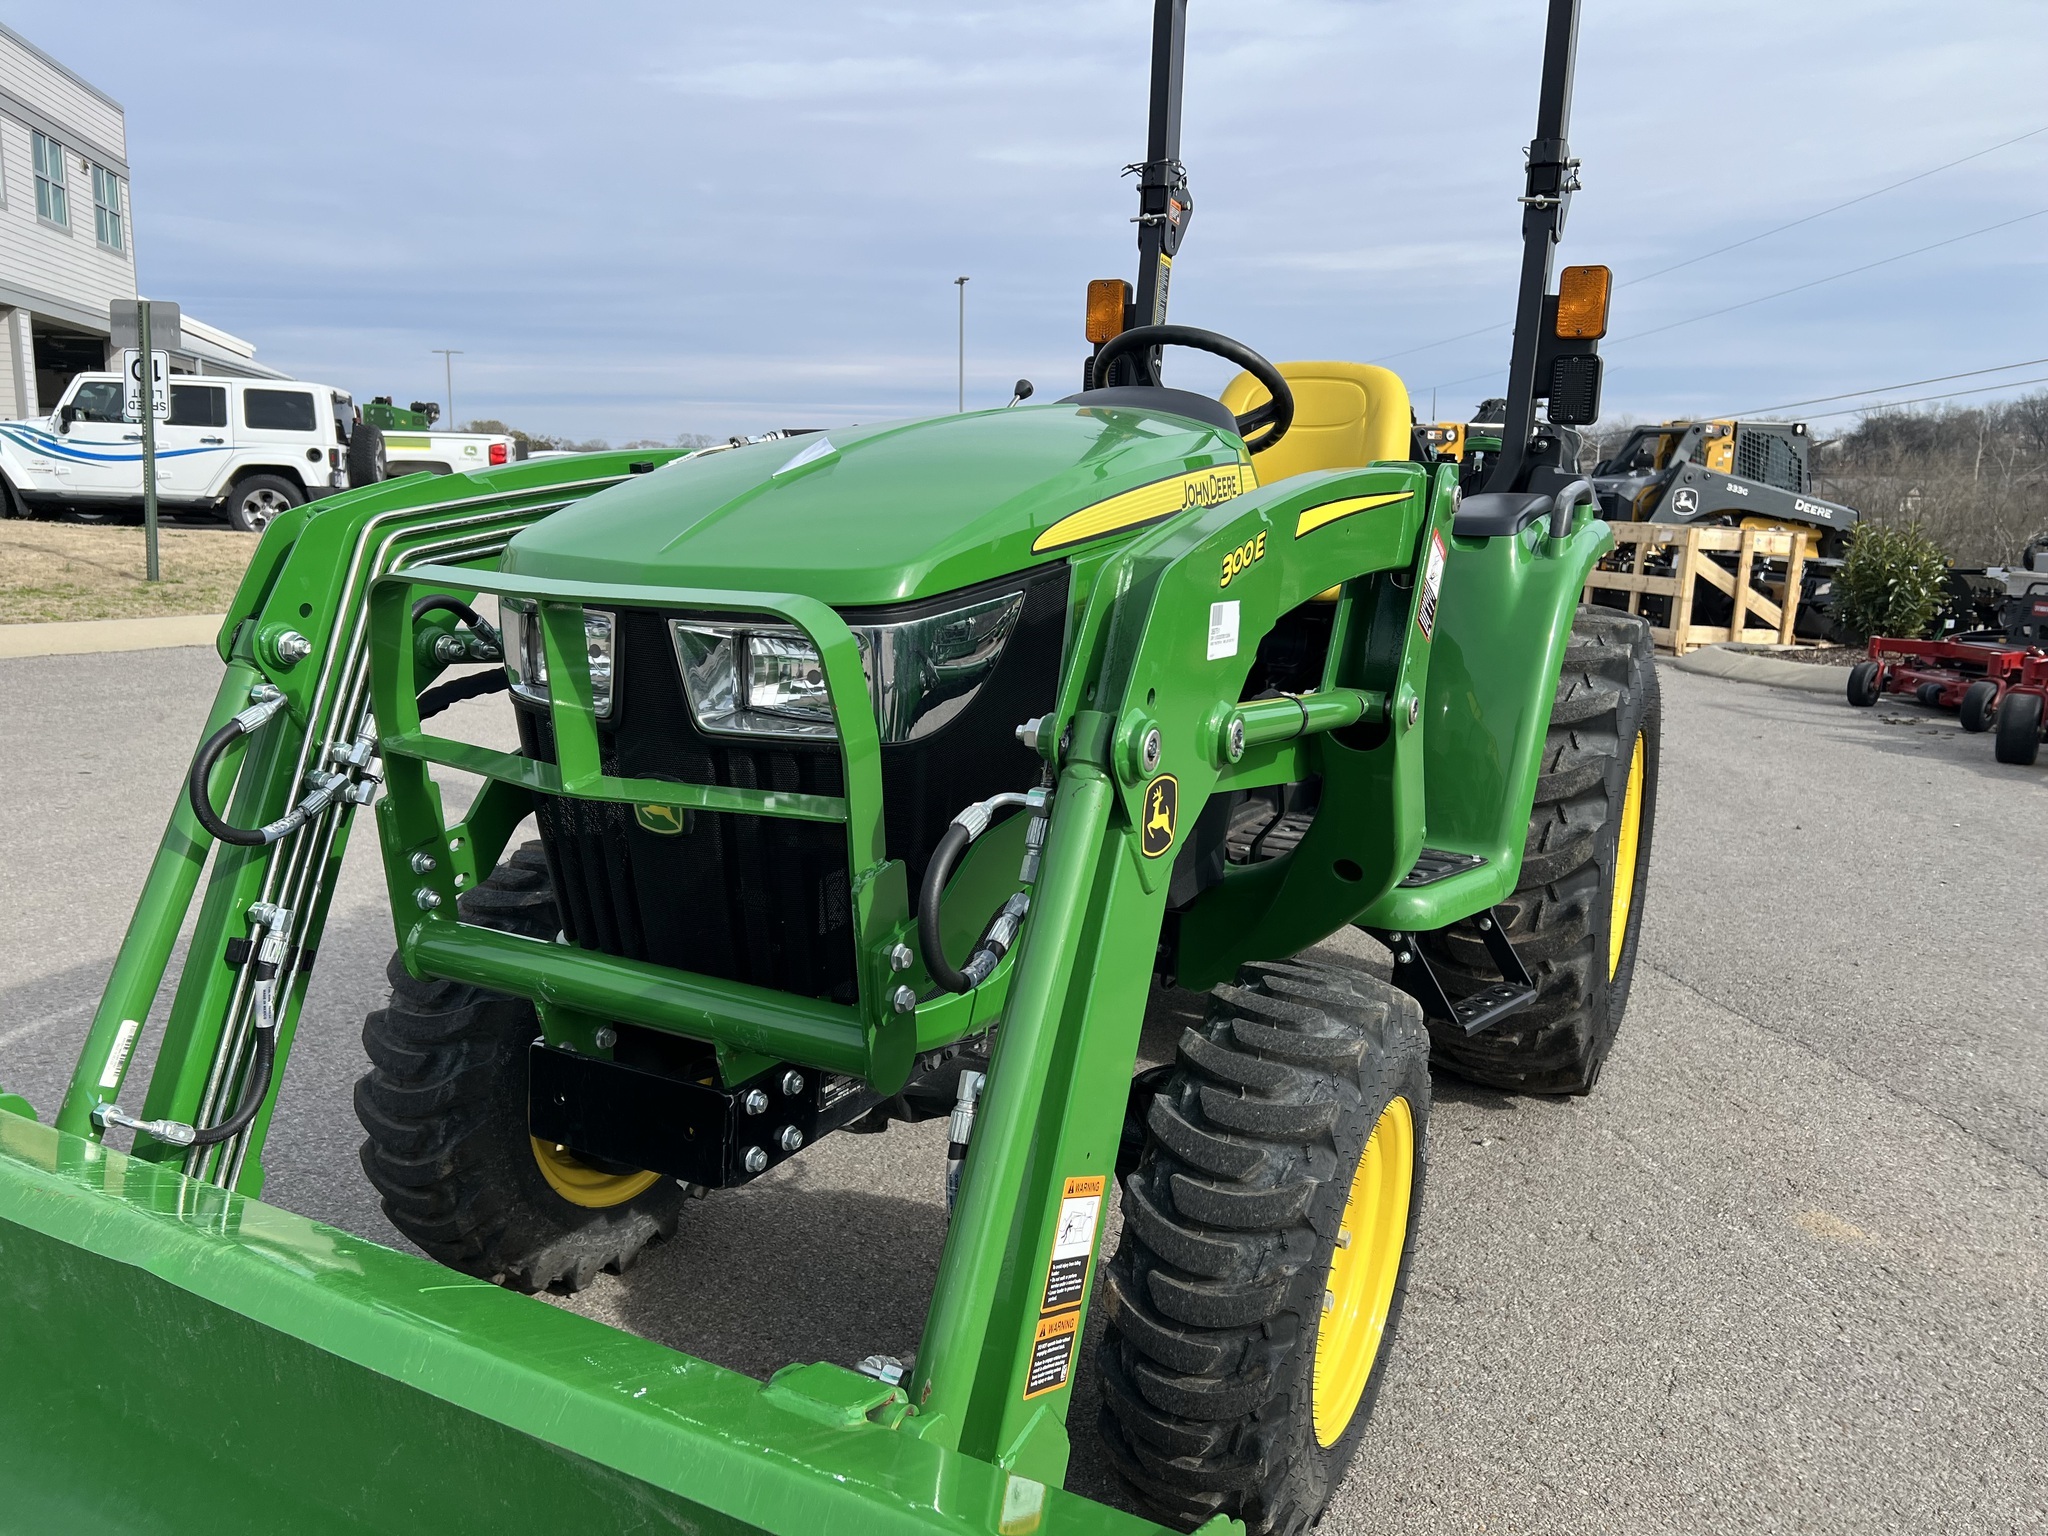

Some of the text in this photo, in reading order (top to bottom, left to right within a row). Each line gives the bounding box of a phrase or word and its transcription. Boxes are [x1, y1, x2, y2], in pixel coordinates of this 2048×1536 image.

[131, 388, 163, 399] LIIT
[128, 400, 167, 412] SPED
[1182, 474, 1237, 509] JOHN DEERE
[1794, 498, 1833, 519] DEERE
[1219, 528, 1268, 589] 300E
[1075, 1181, 1100, 1193] WARNING
[1048, 1317, 1074, 1334] WARNING
